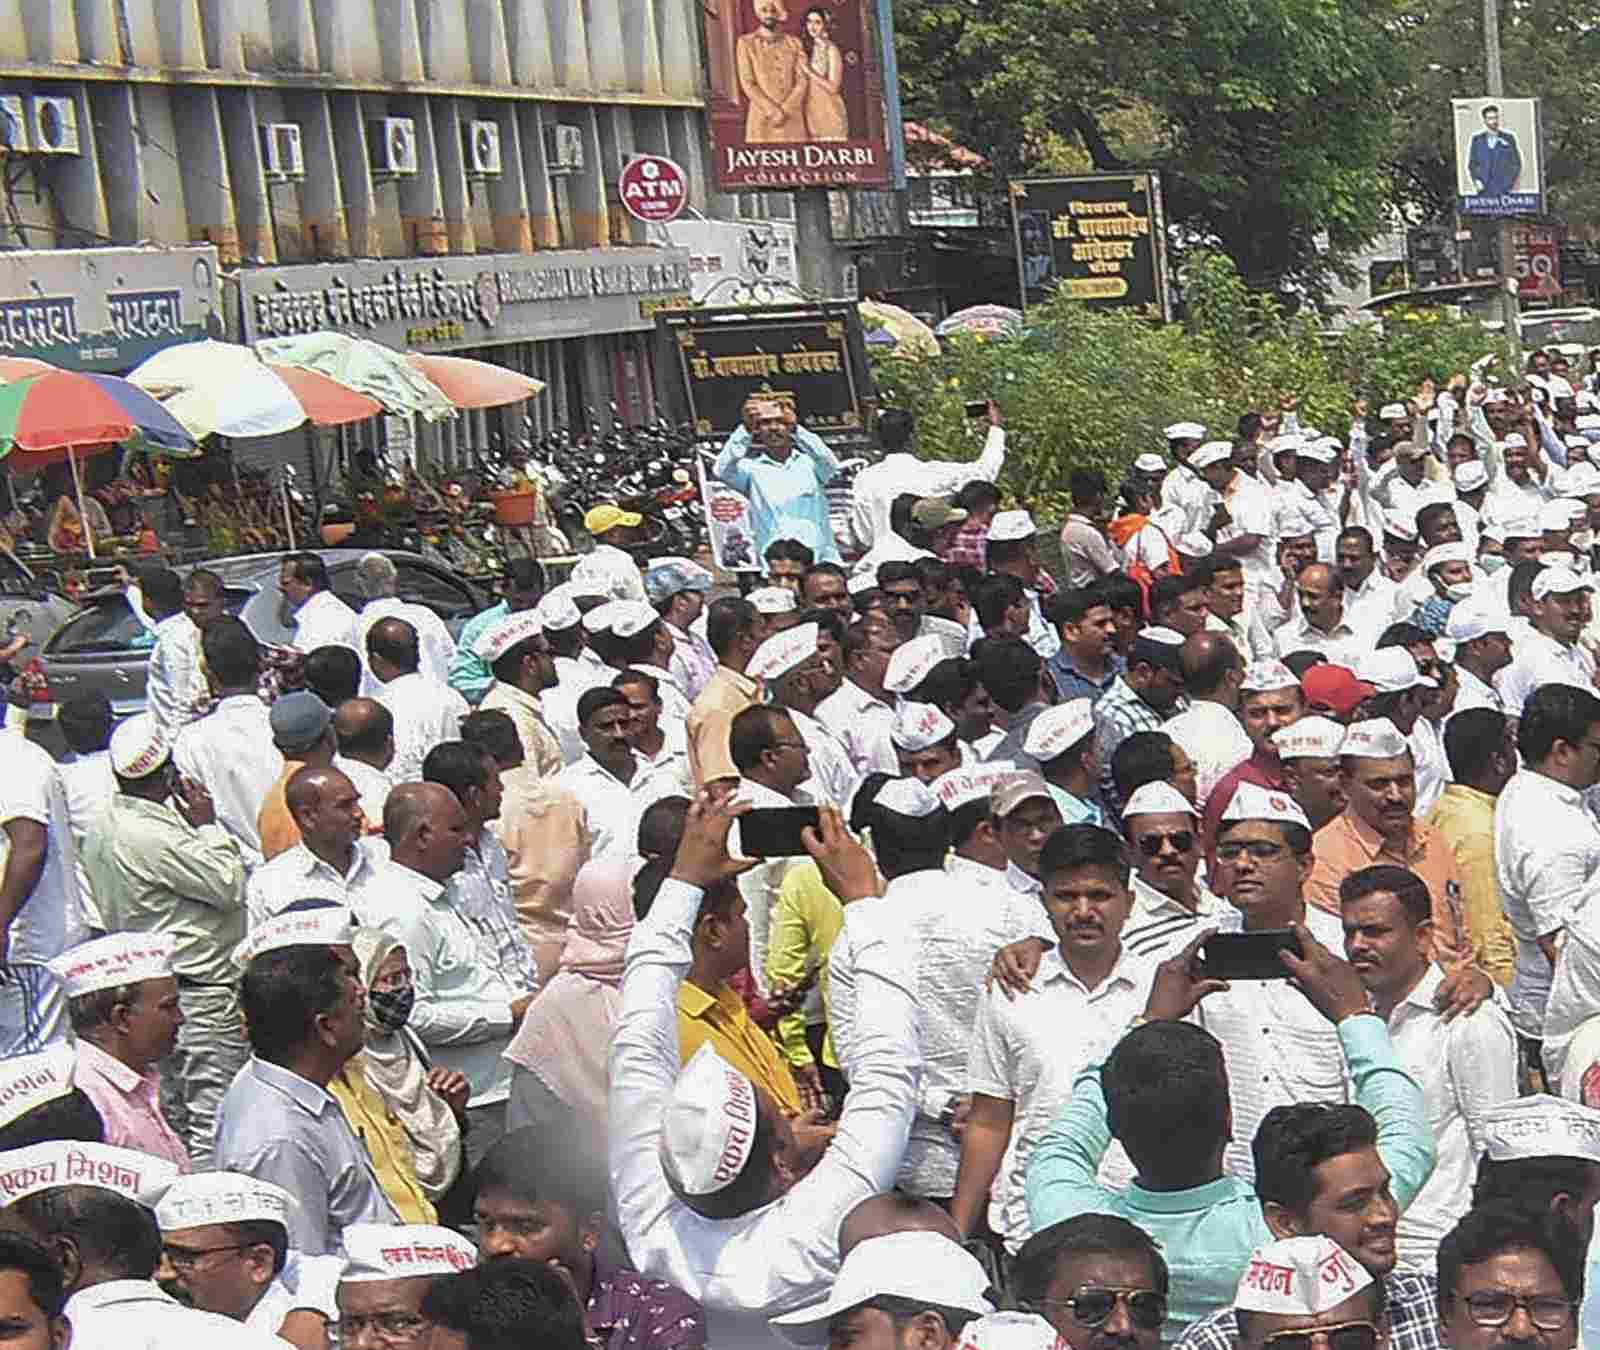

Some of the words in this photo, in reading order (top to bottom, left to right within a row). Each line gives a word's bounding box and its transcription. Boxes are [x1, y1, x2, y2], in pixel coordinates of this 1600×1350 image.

[728, 146, 798, 171] JAYESH
[805, 145, 874, 167] DARBI
[744, 169, 860, 183] COLLECTION
[626, 180, 680, 198] ATM
[65, 1149, 141, 1195] मिशन
